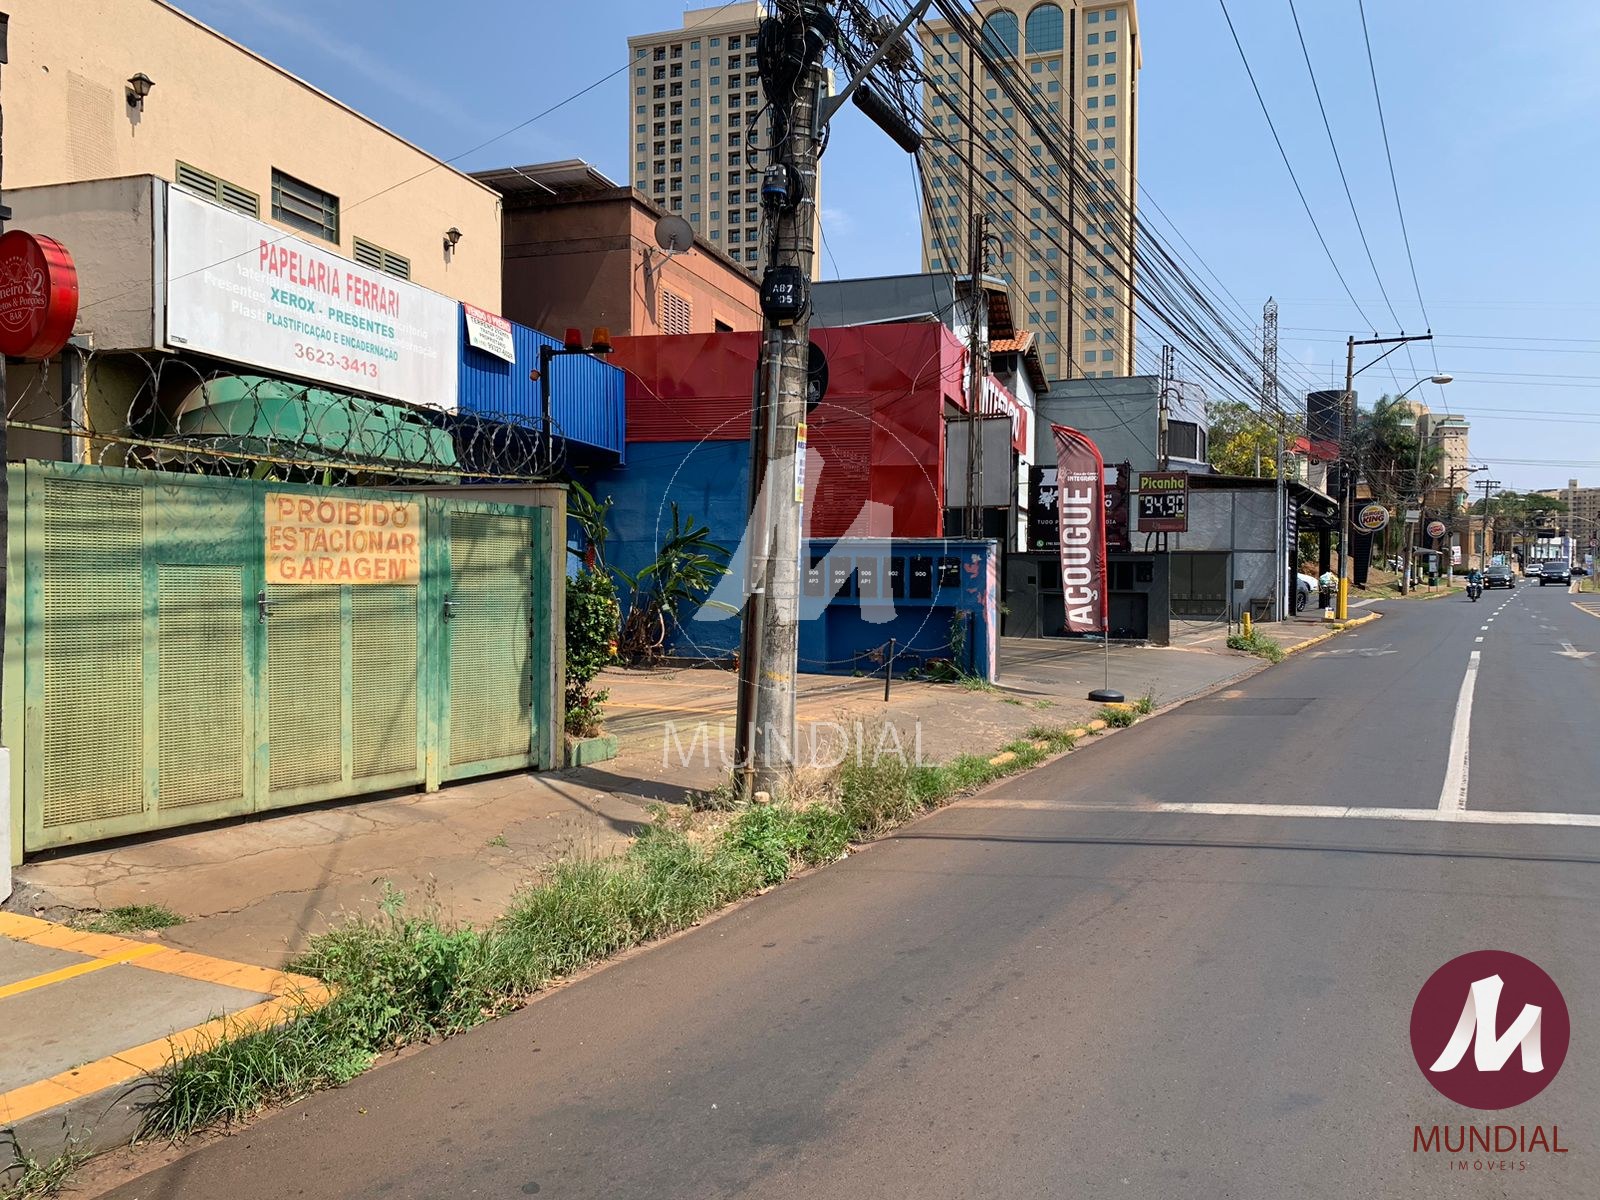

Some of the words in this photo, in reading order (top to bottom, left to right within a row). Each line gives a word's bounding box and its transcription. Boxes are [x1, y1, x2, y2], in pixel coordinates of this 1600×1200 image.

[259, 239, 340, 299] PAPELARIA
[346, 272, 400, 319] FERRARI
[772, 283, 793, 293] A87
[270, 287, 316, 314] XEROX
[328, 307, 395, 339] PRESENTES
[470, 316, 494, 332] TERRENO
[266, 312, 332, 342] PLASTIFICAÇÃO
[333, 332, 339, 343] E
[341, 334, 399, 362] ENCADERNAÇÃO
[293, 342, 378, 378] 3623-3413
[1141, 476, 1185, 489] Picanha
[278, 497, 409, 529] PROIBIDO
[1145, 495, 1185, 516] 94,90
[1363, 510, 1385, 518] BURGER
[1363, 515, 1385, 524] KING
[269, 525, 417, 555] ESTACIONAR
[1062, 487, 1098, 625] AÇOUGUE
